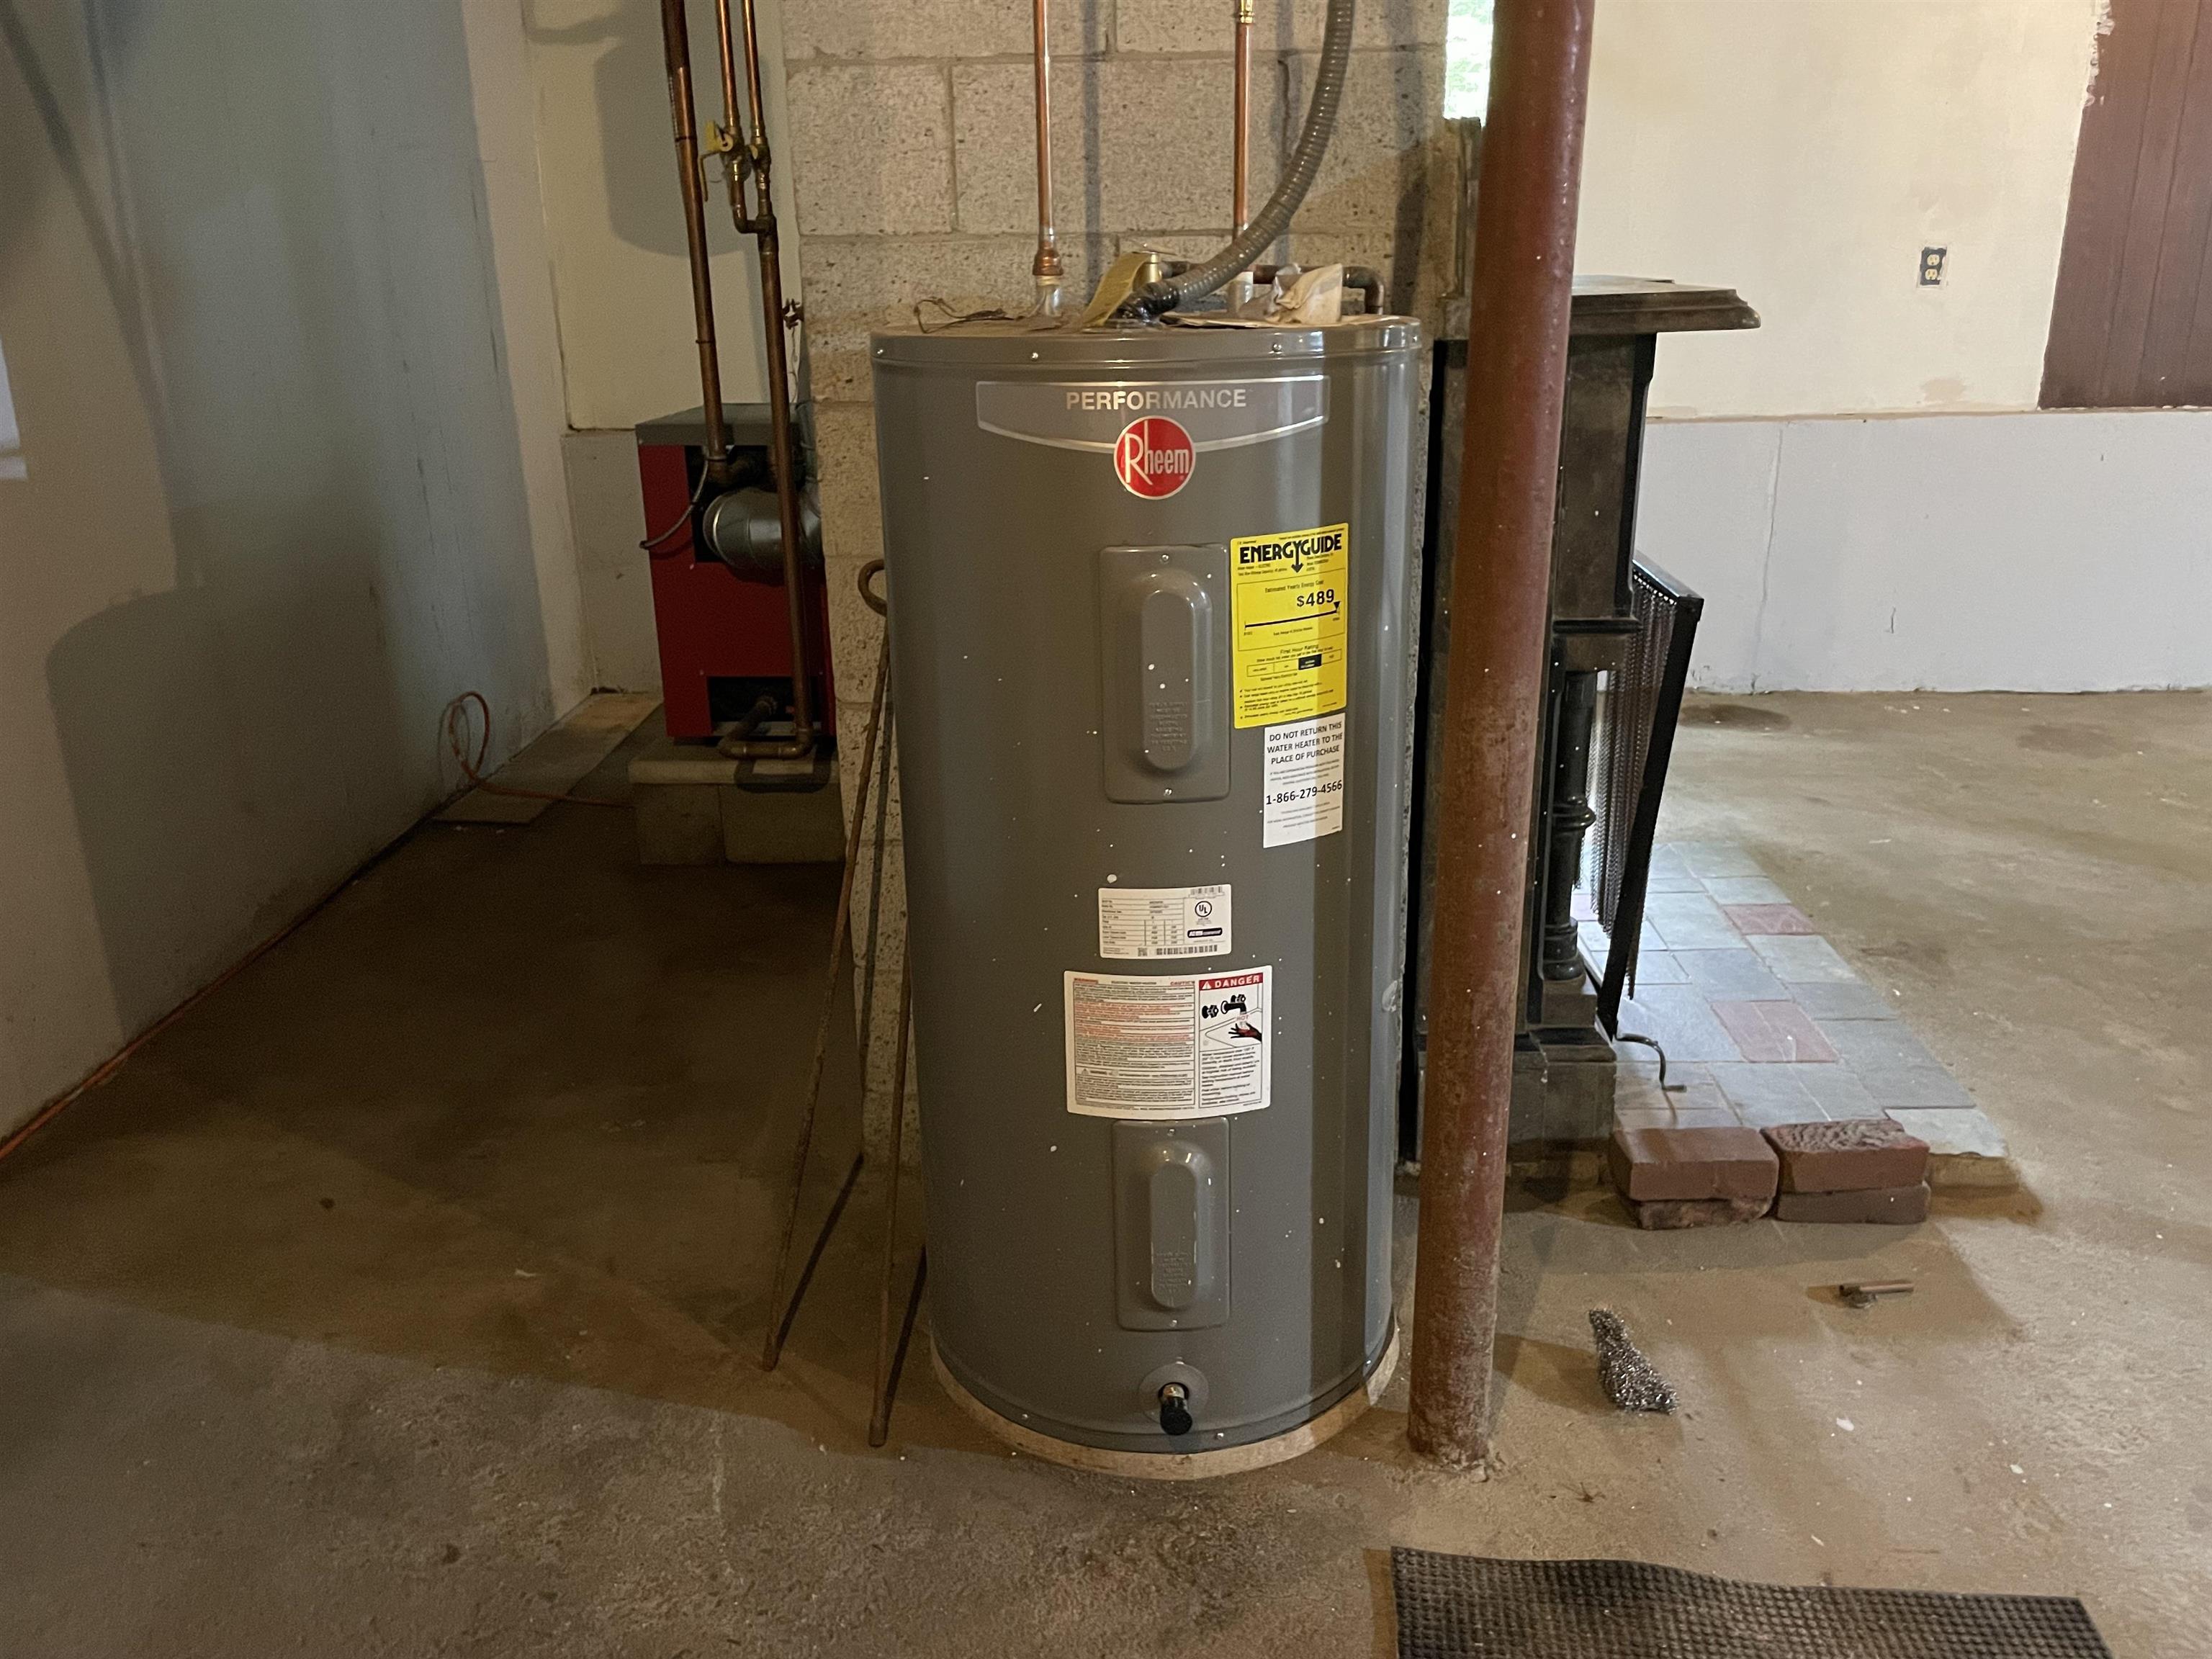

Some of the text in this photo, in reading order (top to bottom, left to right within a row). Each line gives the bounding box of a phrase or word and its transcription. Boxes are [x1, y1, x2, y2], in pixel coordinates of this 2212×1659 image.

[1066, 389, 1247, 410] PERFORMANCE
[1124, 420, 1189, 485] Rheem
[1240, 533, 1342, 565] ENERGYGUIDE
[1297, 589, 1334, 608] $489
[1283, 730, 1299, 739] NOT
[1300, 726, 1327, 737] RETURN
[1328, 721, 1342, 730] THIS
[1267, 743, 1292, 753] WATER
[1295, 738, 1320, 749] HEATER
[1332, 732, 1343, 742] THE
[1271, 755, 1293, 765] PLACE
[1306, 745, 1339, 758] PURCHASE
[1266, 780, 1342, 805] 1-866-279-4566
[1199, 904, 1208, 914] UL
[1215, 975, 1260, 988] DANGER
